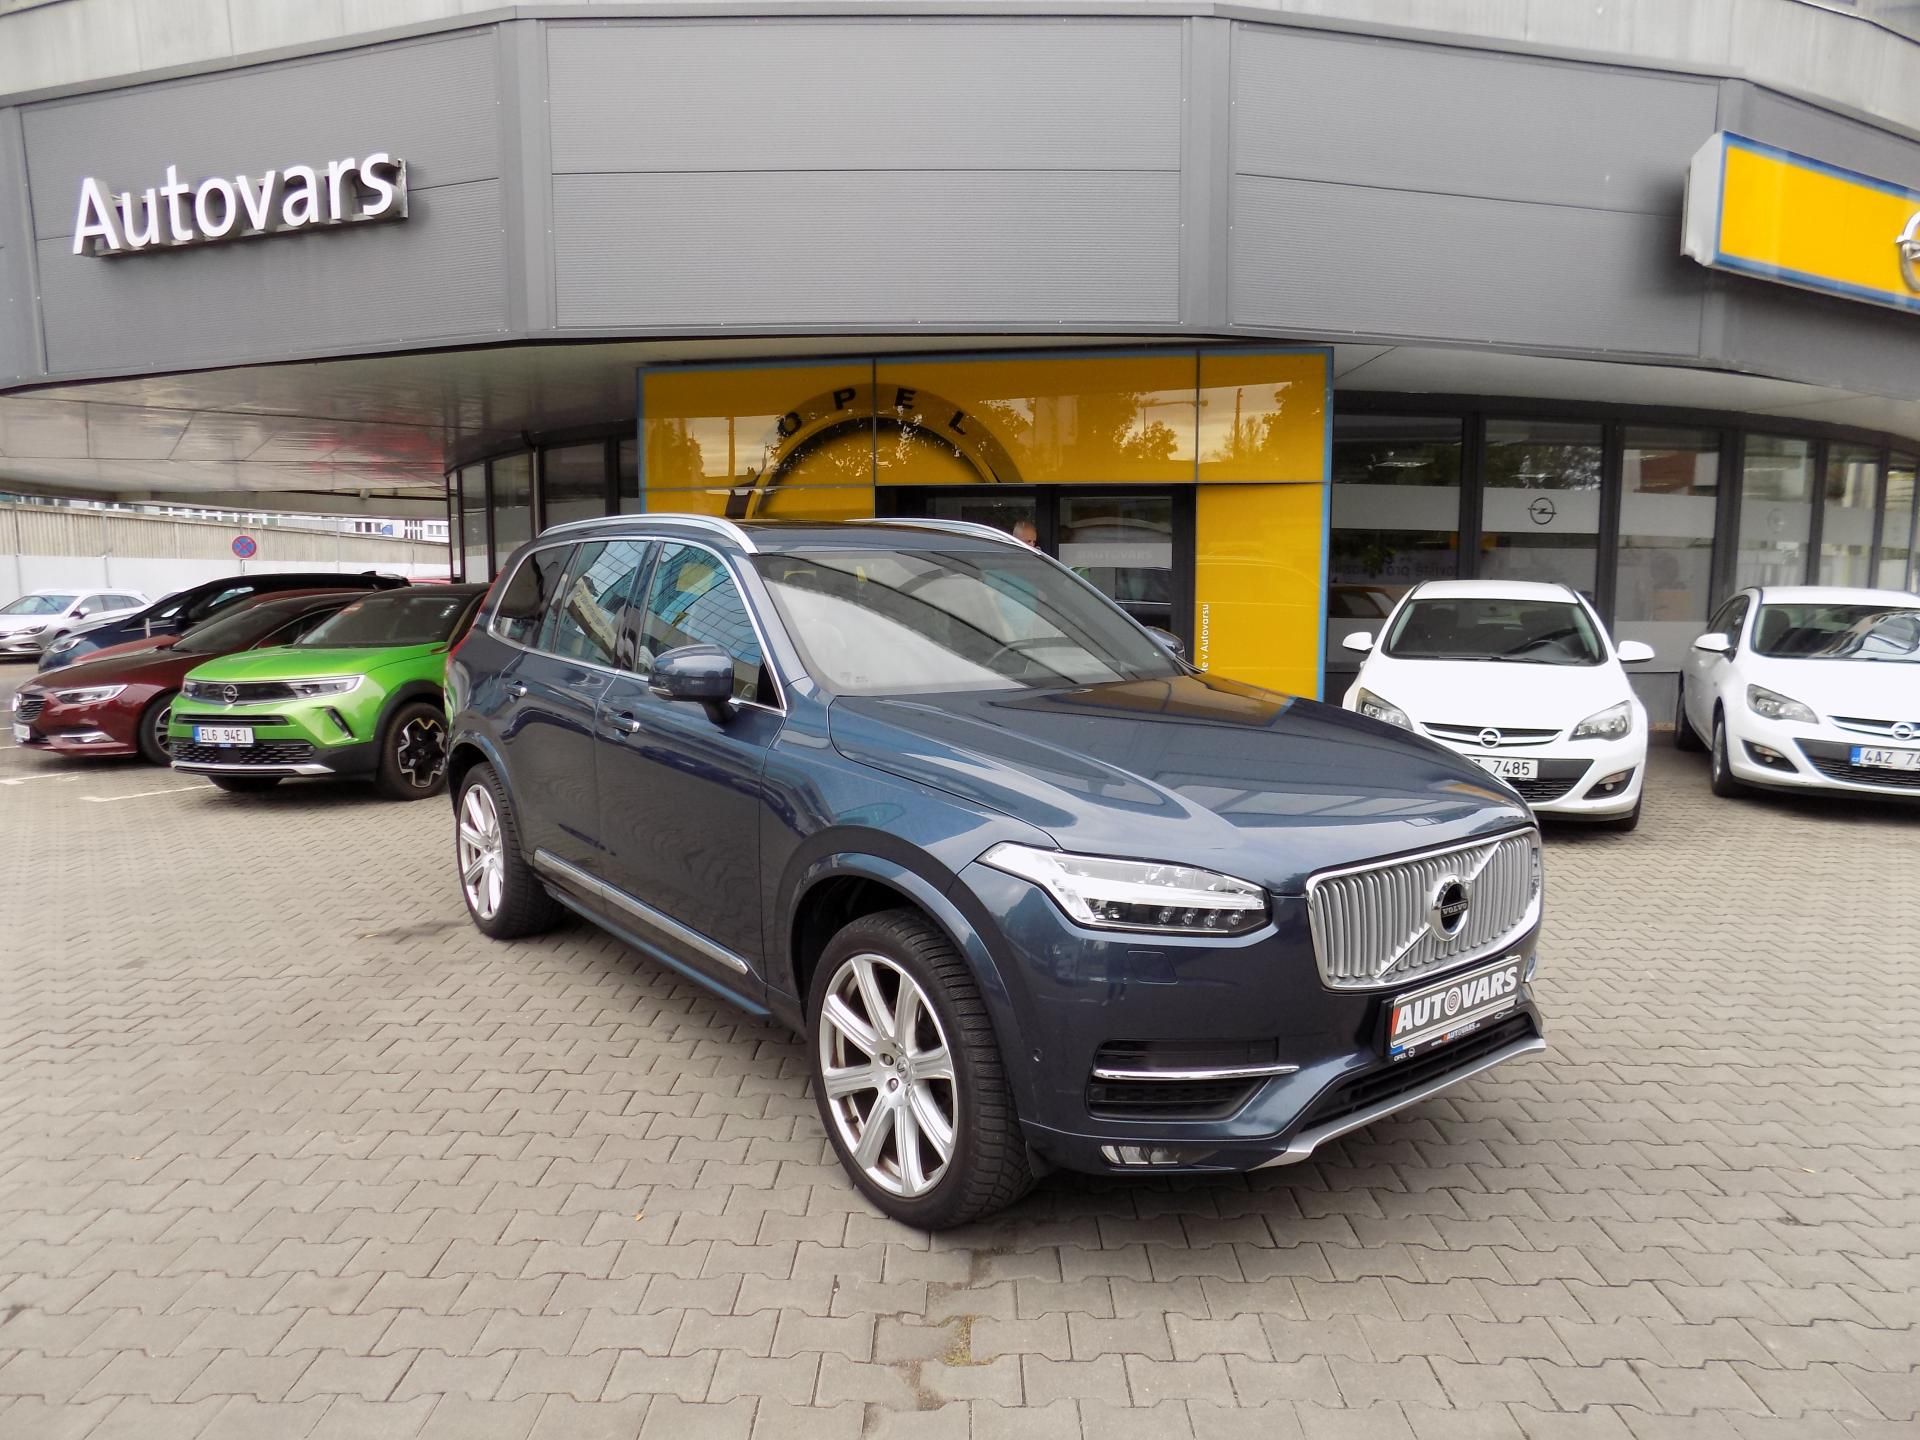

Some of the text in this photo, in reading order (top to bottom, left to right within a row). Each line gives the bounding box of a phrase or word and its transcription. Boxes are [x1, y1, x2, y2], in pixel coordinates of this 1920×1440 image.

[72, 152, 395, 256] Autovars
[777, 387, 967, 438] OPEL
[1200, 604, 1209, 652] Autovarsu
[201, 729, 218, 741] EL6
[1493, 760, 1531, 776] 7485
[1864, 750, 1894, 764] 4AZ
[1442, 902, 1468, 915] VOLVO
[1395, 966, 1518, 1035] AUTOVARS
